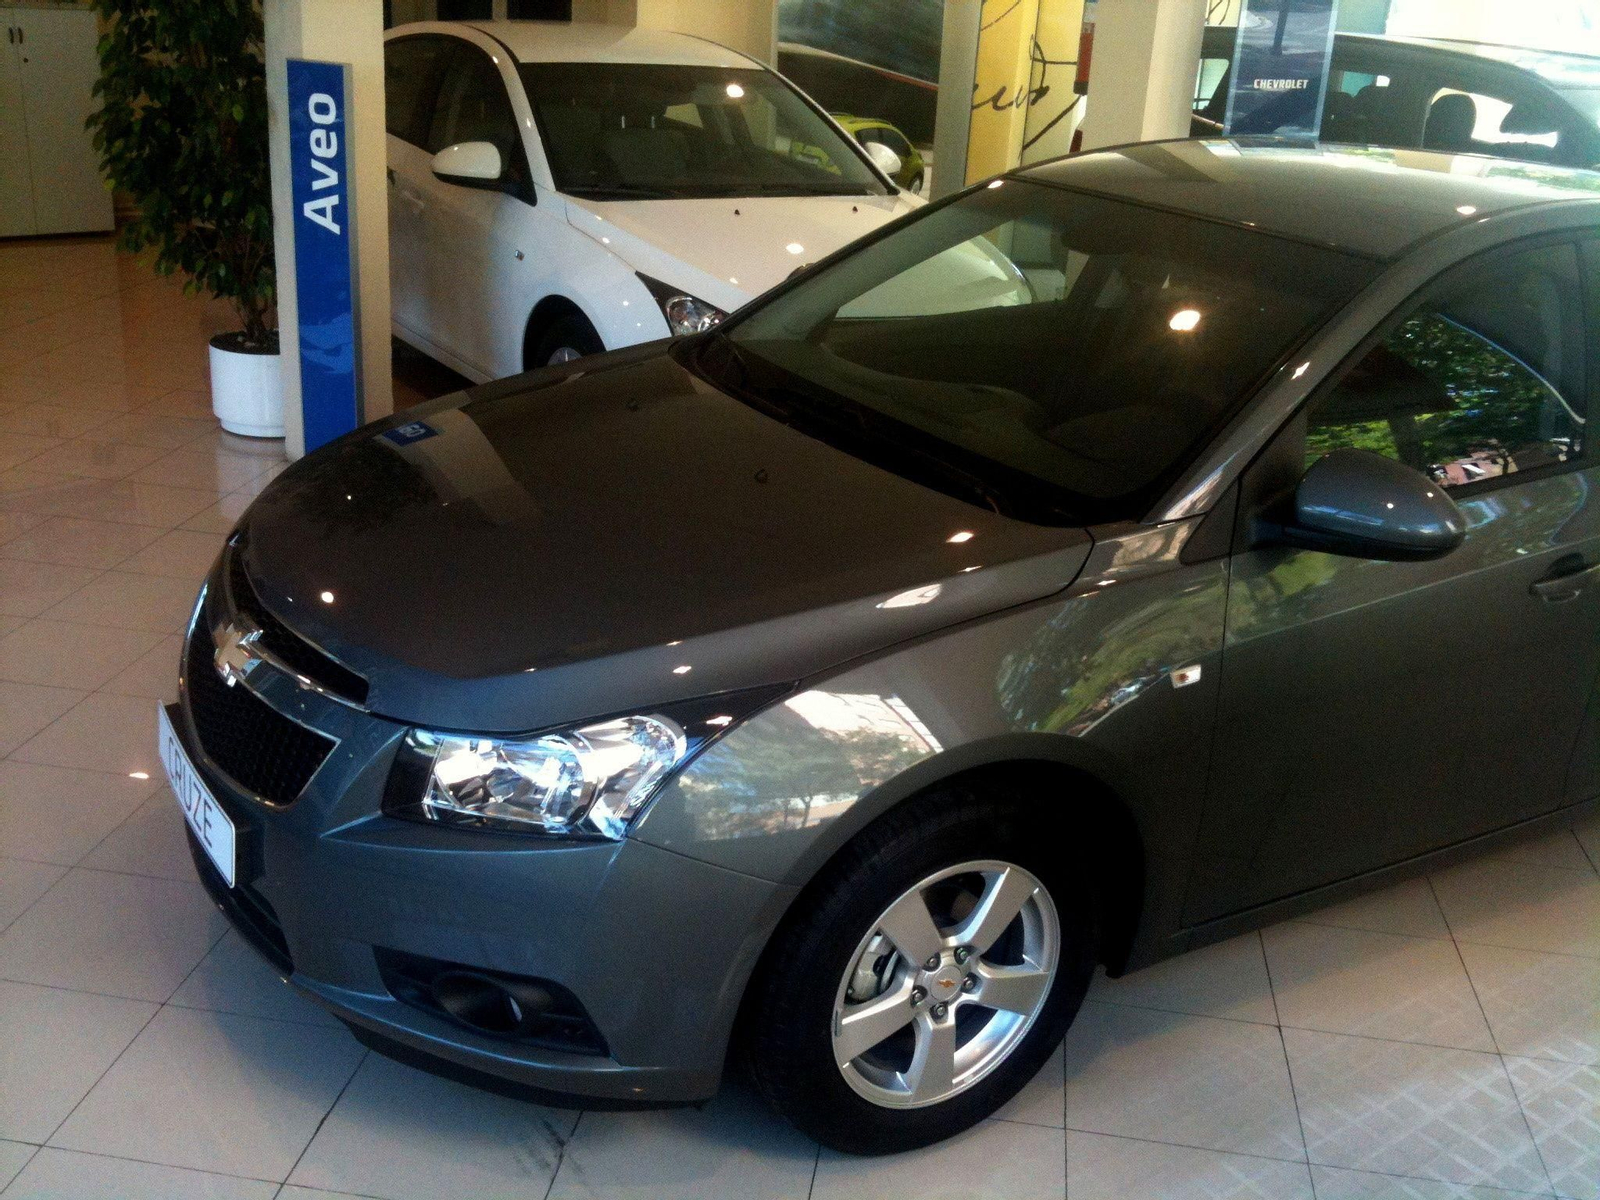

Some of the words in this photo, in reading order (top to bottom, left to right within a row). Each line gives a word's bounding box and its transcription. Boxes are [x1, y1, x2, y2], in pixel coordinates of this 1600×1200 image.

[1253, 79, 1309, 89] CHEVROLET
[303, 93, 341, 235] Aveo
[168, 736, 213, 848] CRUZE
